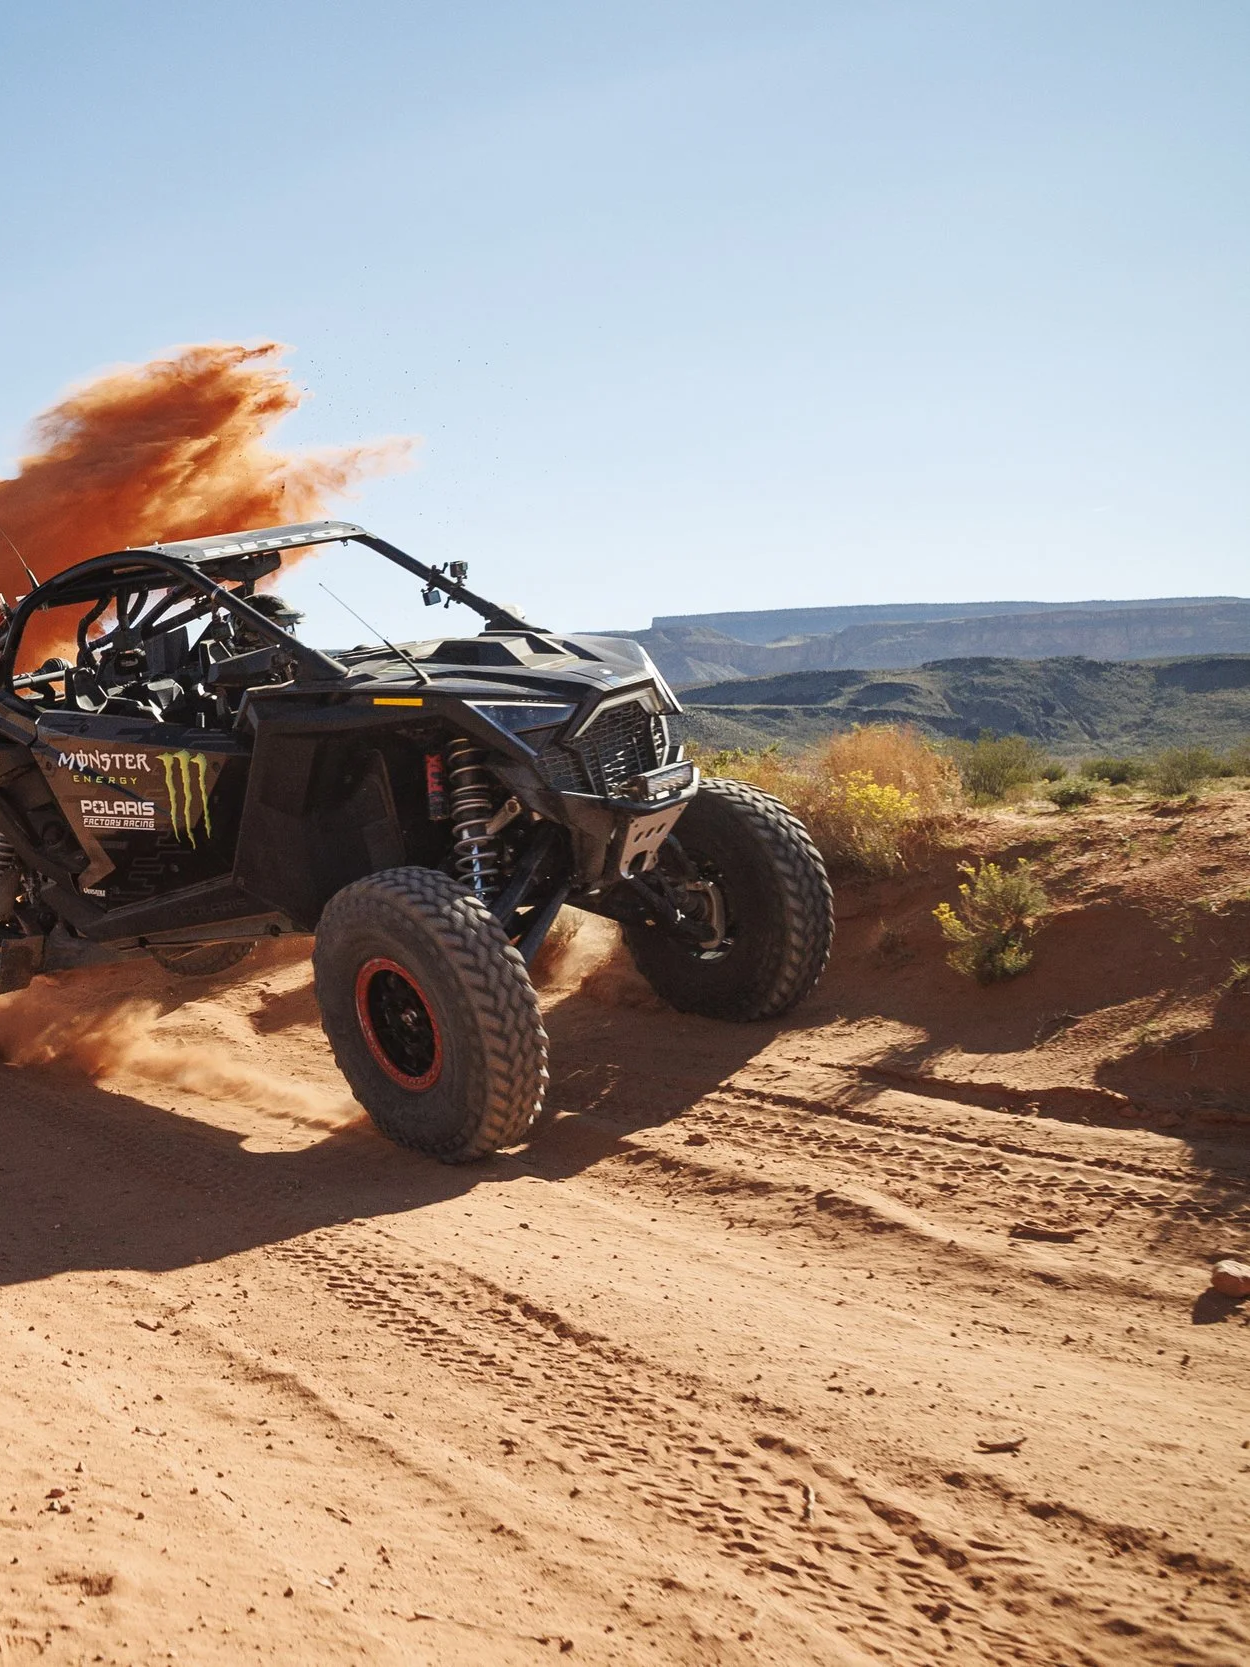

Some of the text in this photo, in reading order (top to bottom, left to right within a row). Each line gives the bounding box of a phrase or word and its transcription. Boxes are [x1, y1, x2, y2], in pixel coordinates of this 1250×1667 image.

[203, 528, 343, 557] NITTO
[58, 749, 151, 772] MONSTER
[73, 774, 138, 785] ENERGY
[80, 799, 155, 816] POLARIS
[83, 817, 155, 828] FACTORY RACING
